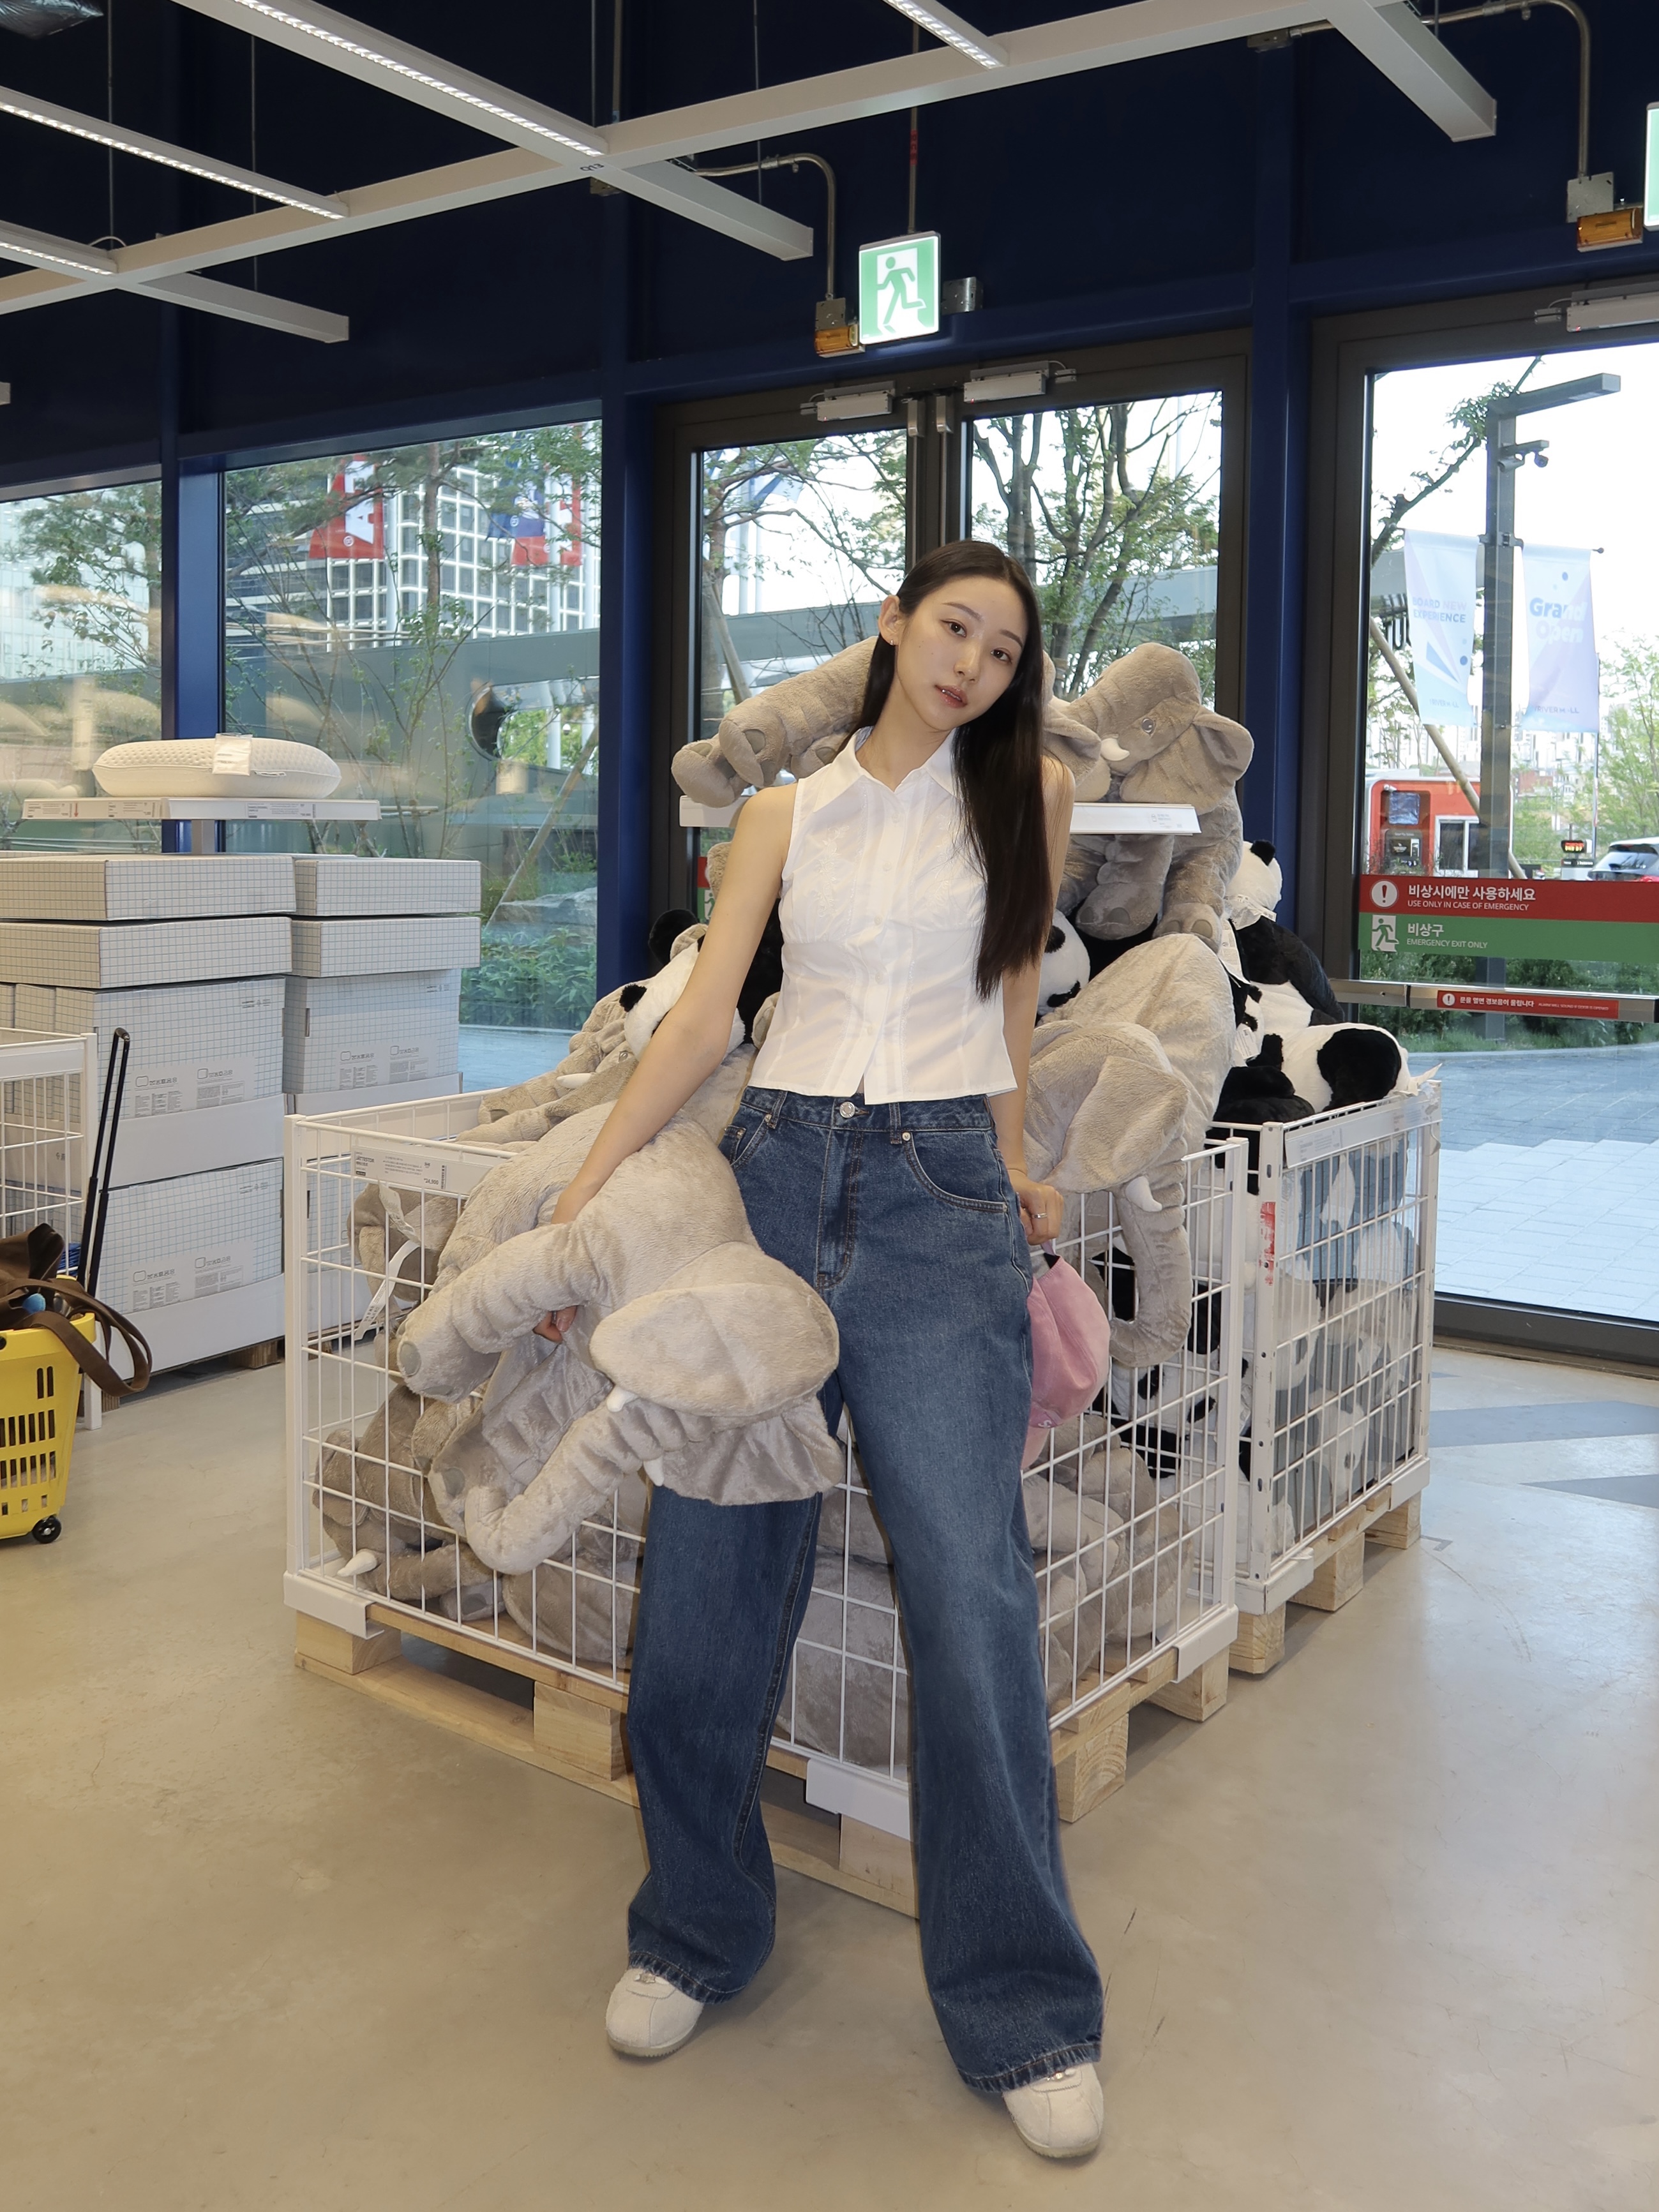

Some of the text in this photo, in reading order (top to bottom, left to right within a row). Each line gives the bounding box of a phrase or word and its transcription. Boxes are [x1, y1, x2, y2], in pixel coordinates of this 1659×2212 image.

[1413, 597, 1467, 611] BOARD NEW
[1529, 597, 1588, 621] Grand
[1413, 609, 1466, 623] EXPERIENCE
[1536, 620, 1583, 645] Open
[1408, 885, 1536, 901] 비상시에만 사용하세요
[1484, 902, 1529, 911] EMERGENCY
[1408, 923, 1445, 938] 비상구
[1407, 938, 1450, 947] EMERGENCY
[1468, 941, 1488, 949] ONLY
[1485, 998, 1509, 1006] 경보음이
[1510, 999, 1535, 1008] 울립니다
